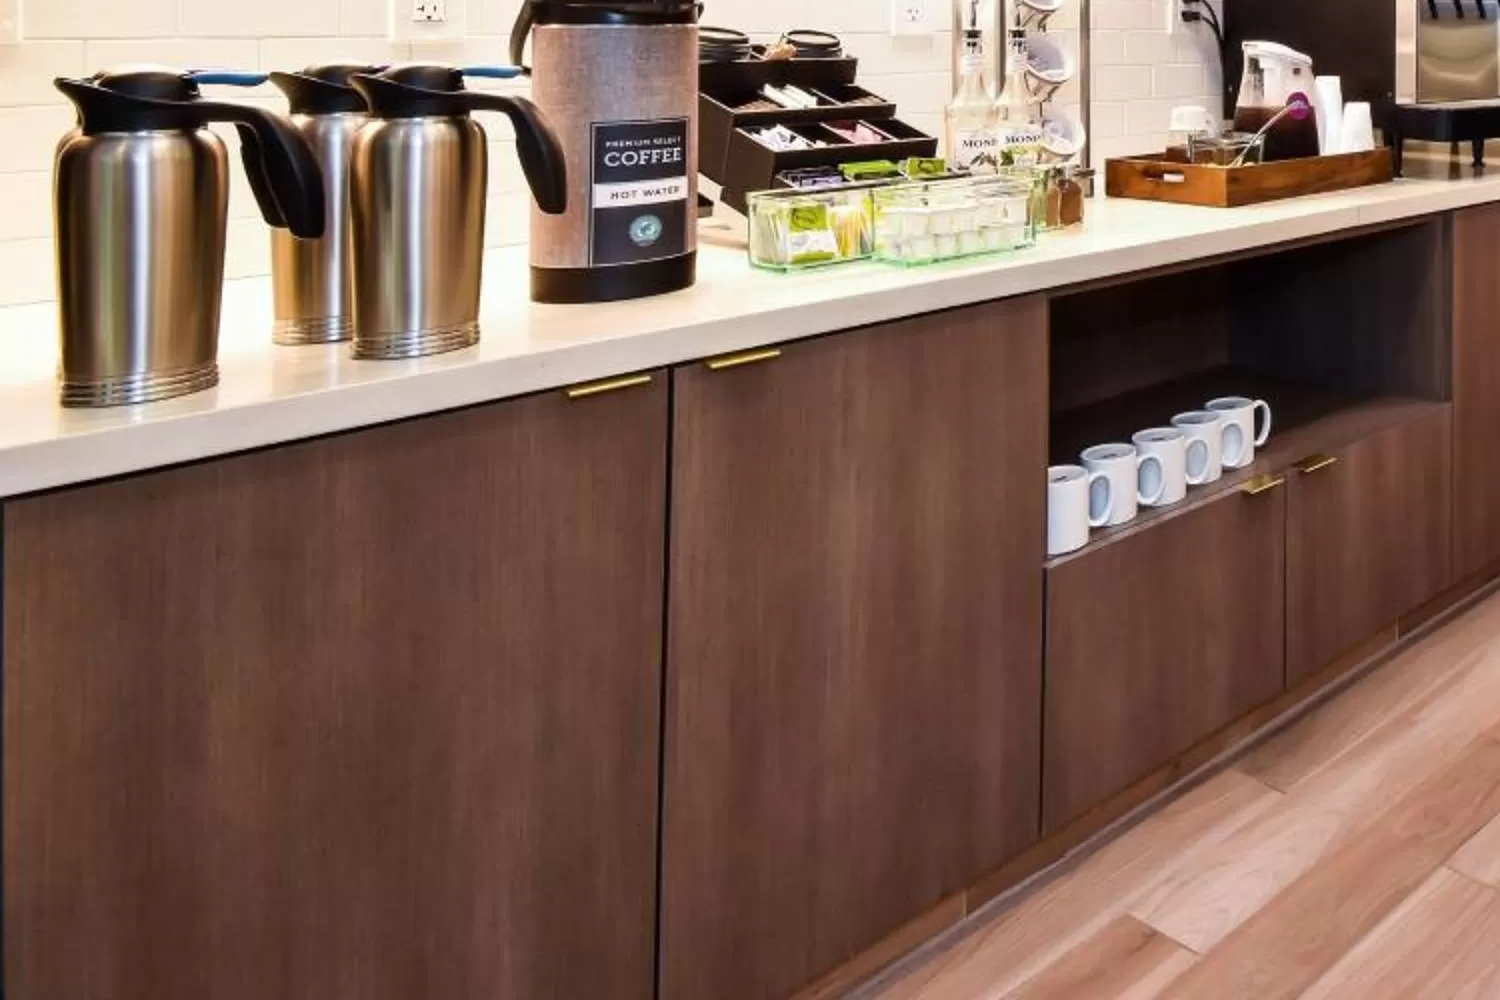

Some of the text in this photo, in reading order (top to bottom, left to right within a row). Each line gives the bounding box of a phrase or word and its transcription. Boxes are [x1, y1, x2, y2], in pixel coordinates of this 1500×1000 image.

[605, 136, 681, 147] PREMIUM SELECT
[604, 147, 681, 166] COFFEE
[610, 186, 680, 200] HOT WATER
